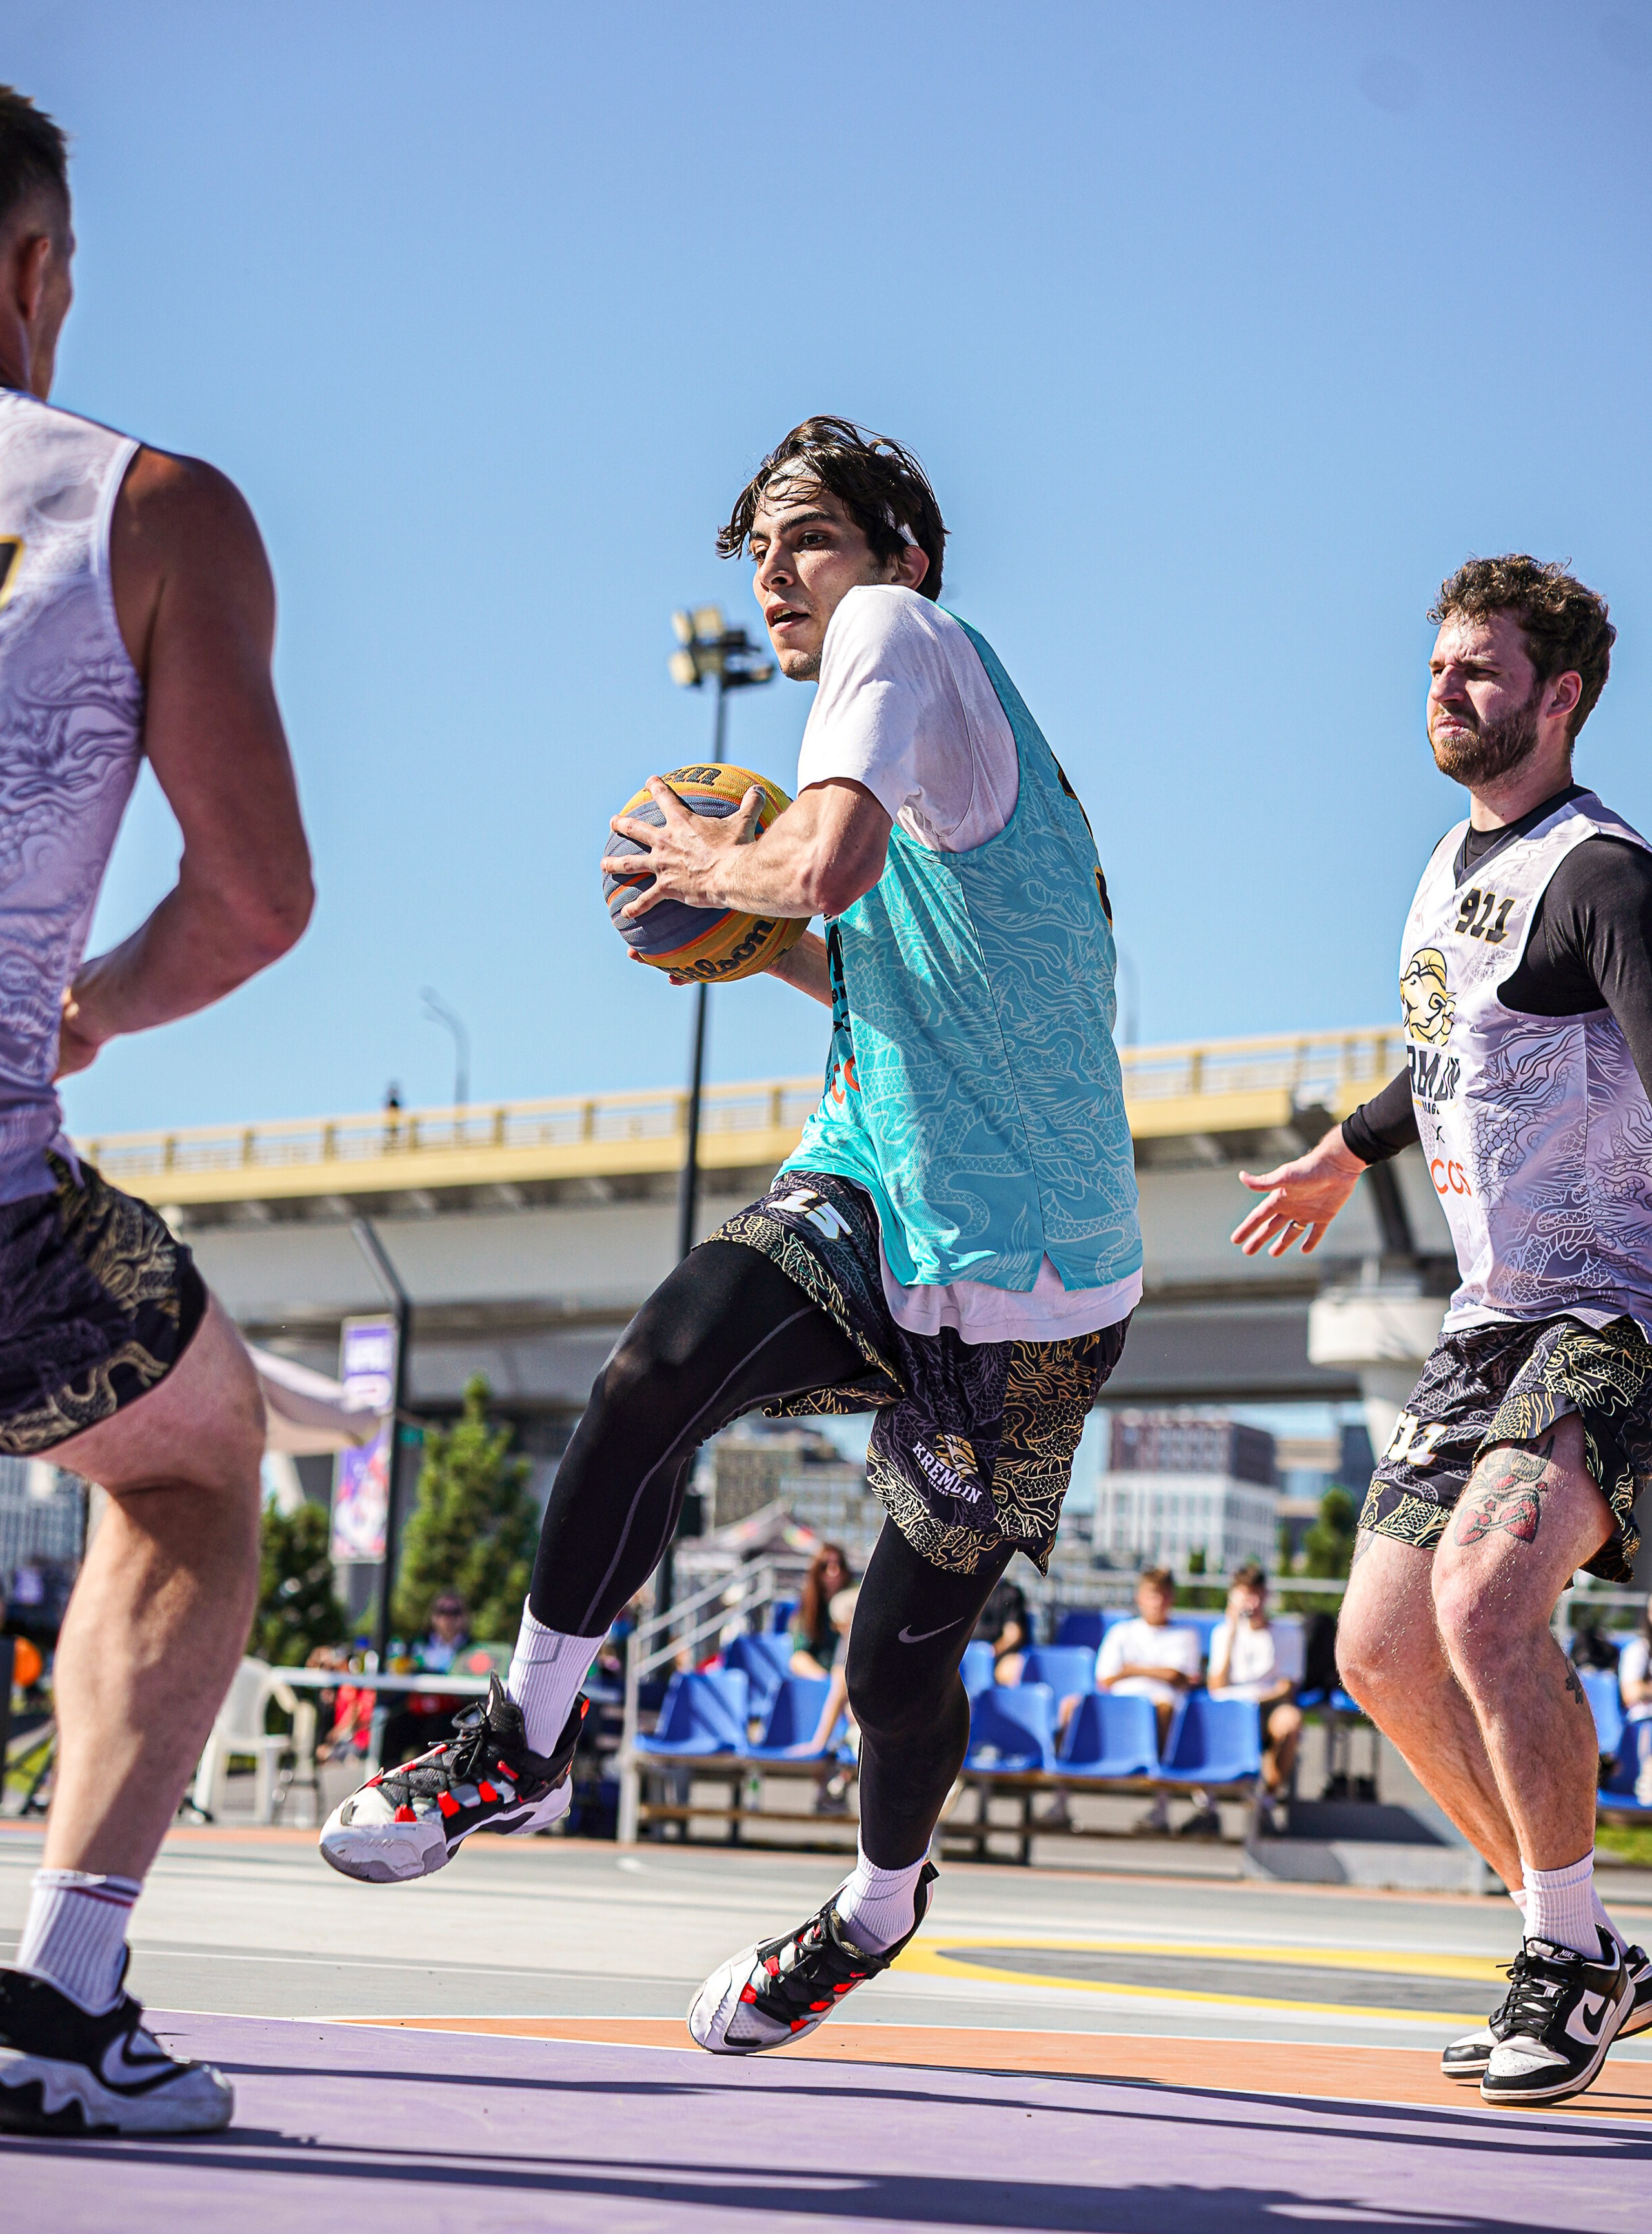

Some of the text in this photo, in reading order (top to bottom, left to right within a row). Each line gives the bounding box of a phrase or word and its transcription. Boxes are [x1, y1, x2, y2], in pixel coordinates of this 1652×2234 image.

[1455, 887, 1516, 945] 911
[912, 1441, 983, 1504] KREMLIN
[927, 1477, 949, 1497] DRAGONS
[1560, 1949, 1576, 1960] NIKE
